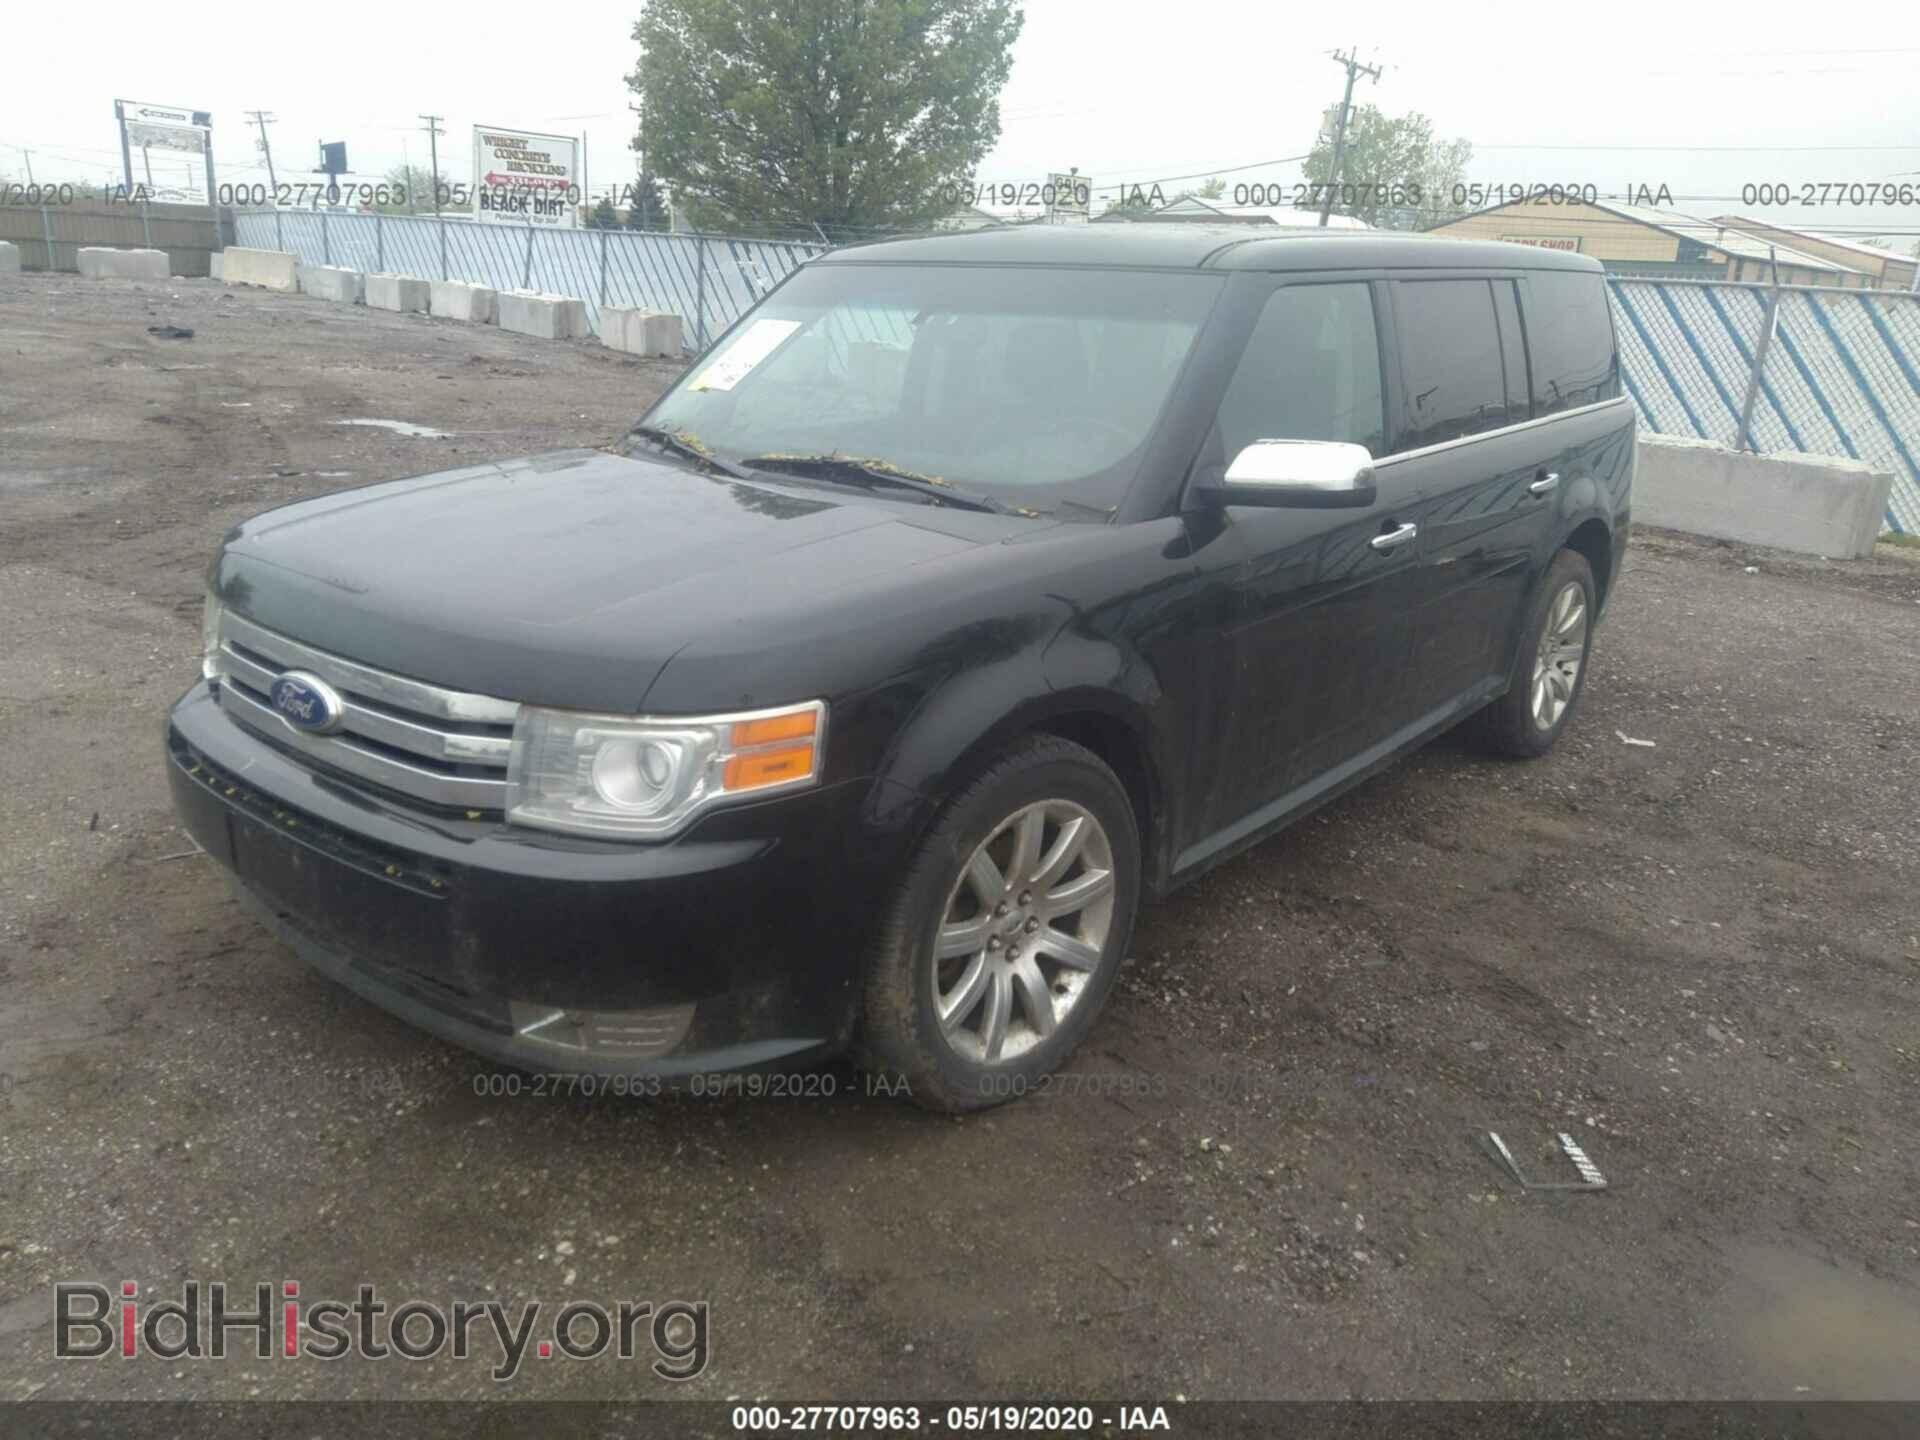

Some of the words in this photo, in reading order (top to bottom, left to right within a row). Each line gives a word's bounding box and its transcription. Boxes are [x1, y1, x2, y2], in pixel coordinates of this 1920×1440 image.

[494, 148, 551, 163] CONCRETE
[506, 160, 566, 177] RECYCLING
[480, 193, 528, 213] BLACK
[533, 198, 565, 216] DIRT
[278, 682, 316, 720] Ford
